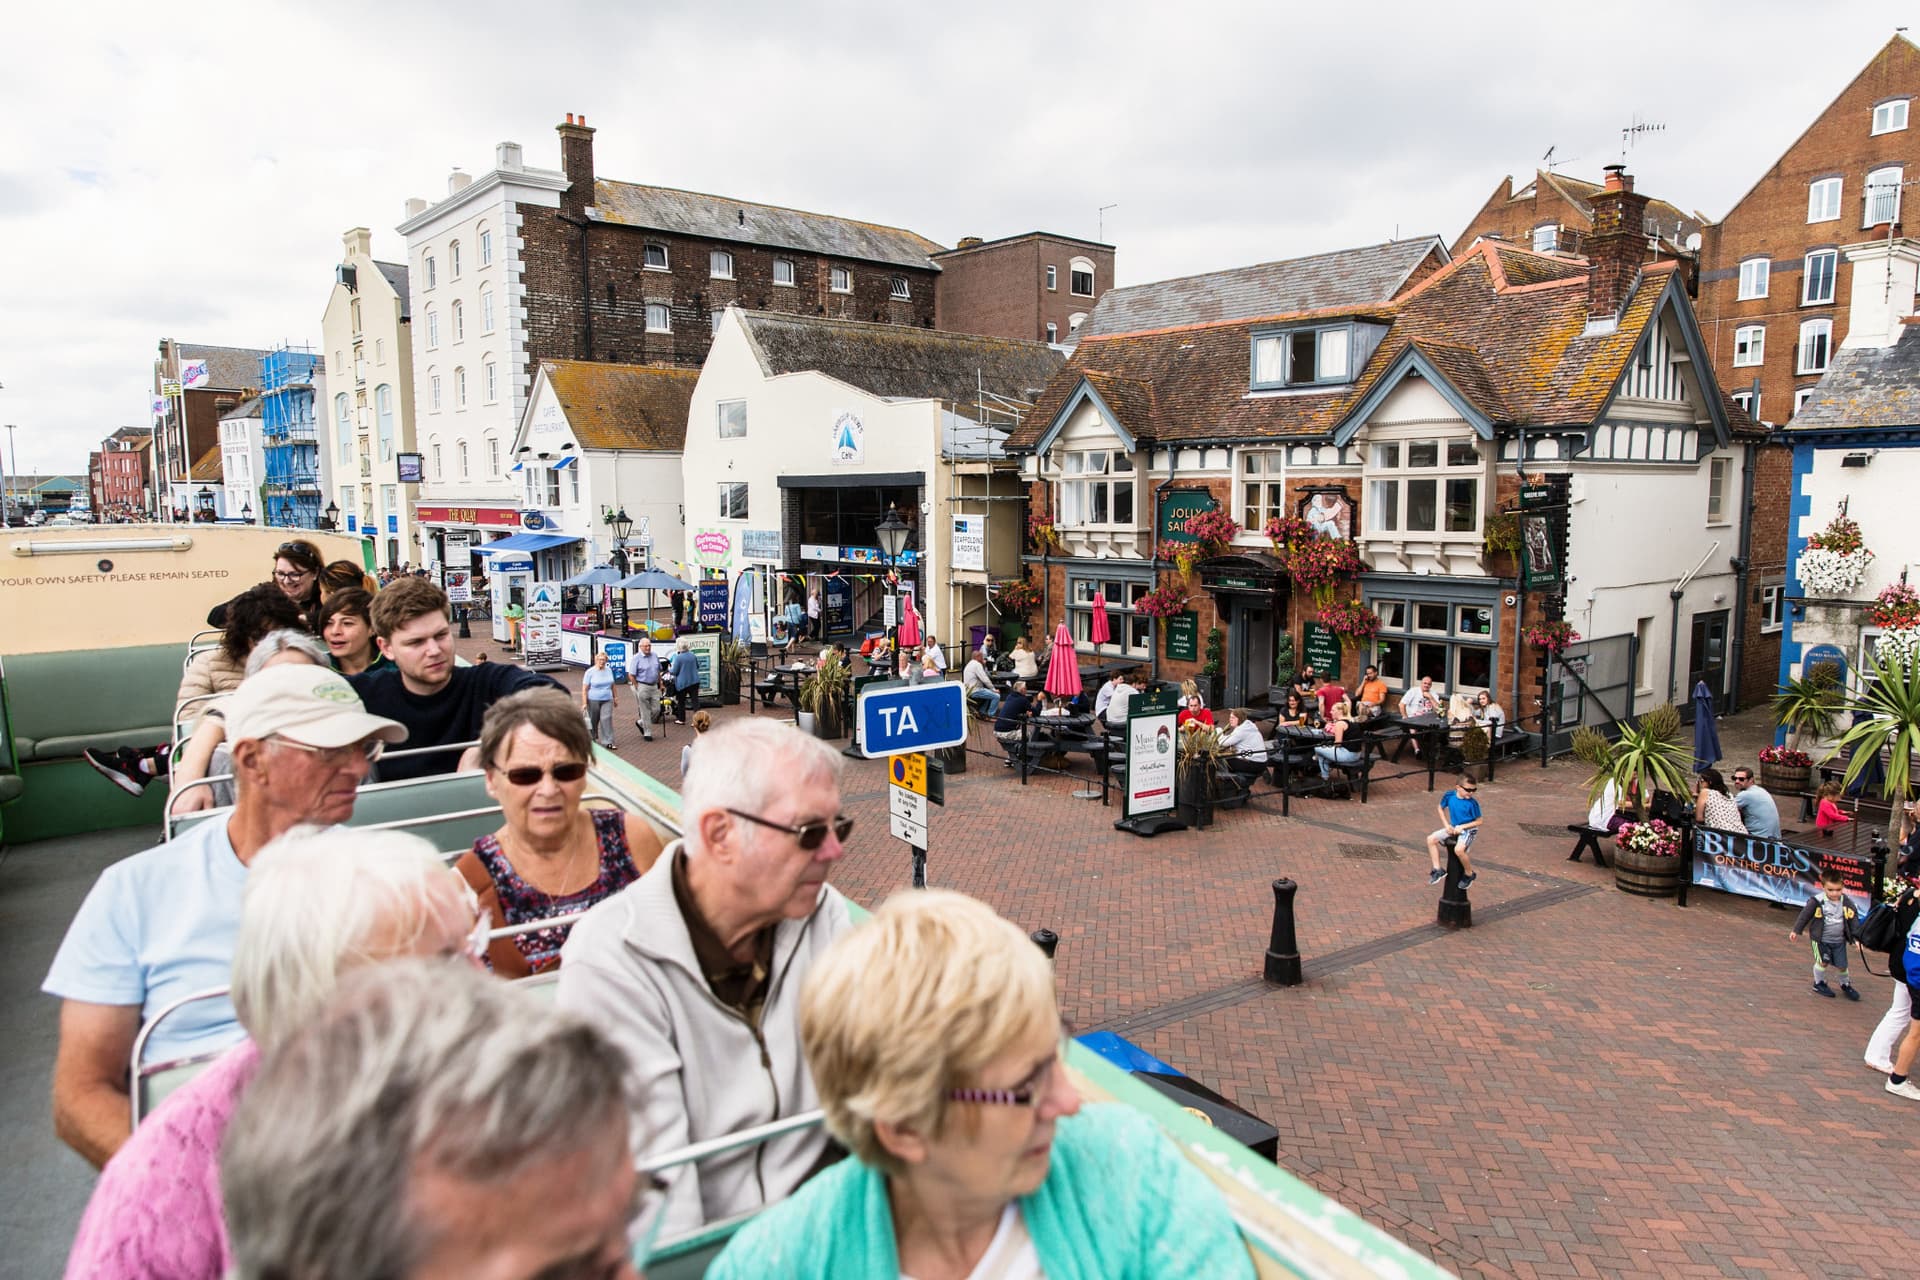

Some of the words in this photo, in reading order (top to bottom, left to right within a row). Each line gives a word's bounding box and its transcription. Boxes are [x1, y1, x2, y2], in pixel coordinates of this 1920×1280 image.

[447, 508, 460, 521] THE
[460, 508, 477, 522] QUAY
[1, 576, 33, 587] YOUR
[35, 575, 66, 586] OWN
[67, 574, 108, 584] SAFETY
[110, 572, 146, 582] PLEASE
[150, 571, 190, 580] REMAIN
[192, 569, 229, 579] SEATED
[703, 601, 725, 610] NOW
[701, 612, 727, 622] OPEN
[1703, 830, 1811, 873] BLUES
[1714, 854, 1736, 866] ON
[1739, 858, 1760, 872] THE
[1763, 863, 1798, 879] QUAY
[1835, 856, 1859, 866] ACTS
[1830, 863, 1865, 876] VENUES
[1702, 861, 1810, 899] FESTIVAL
